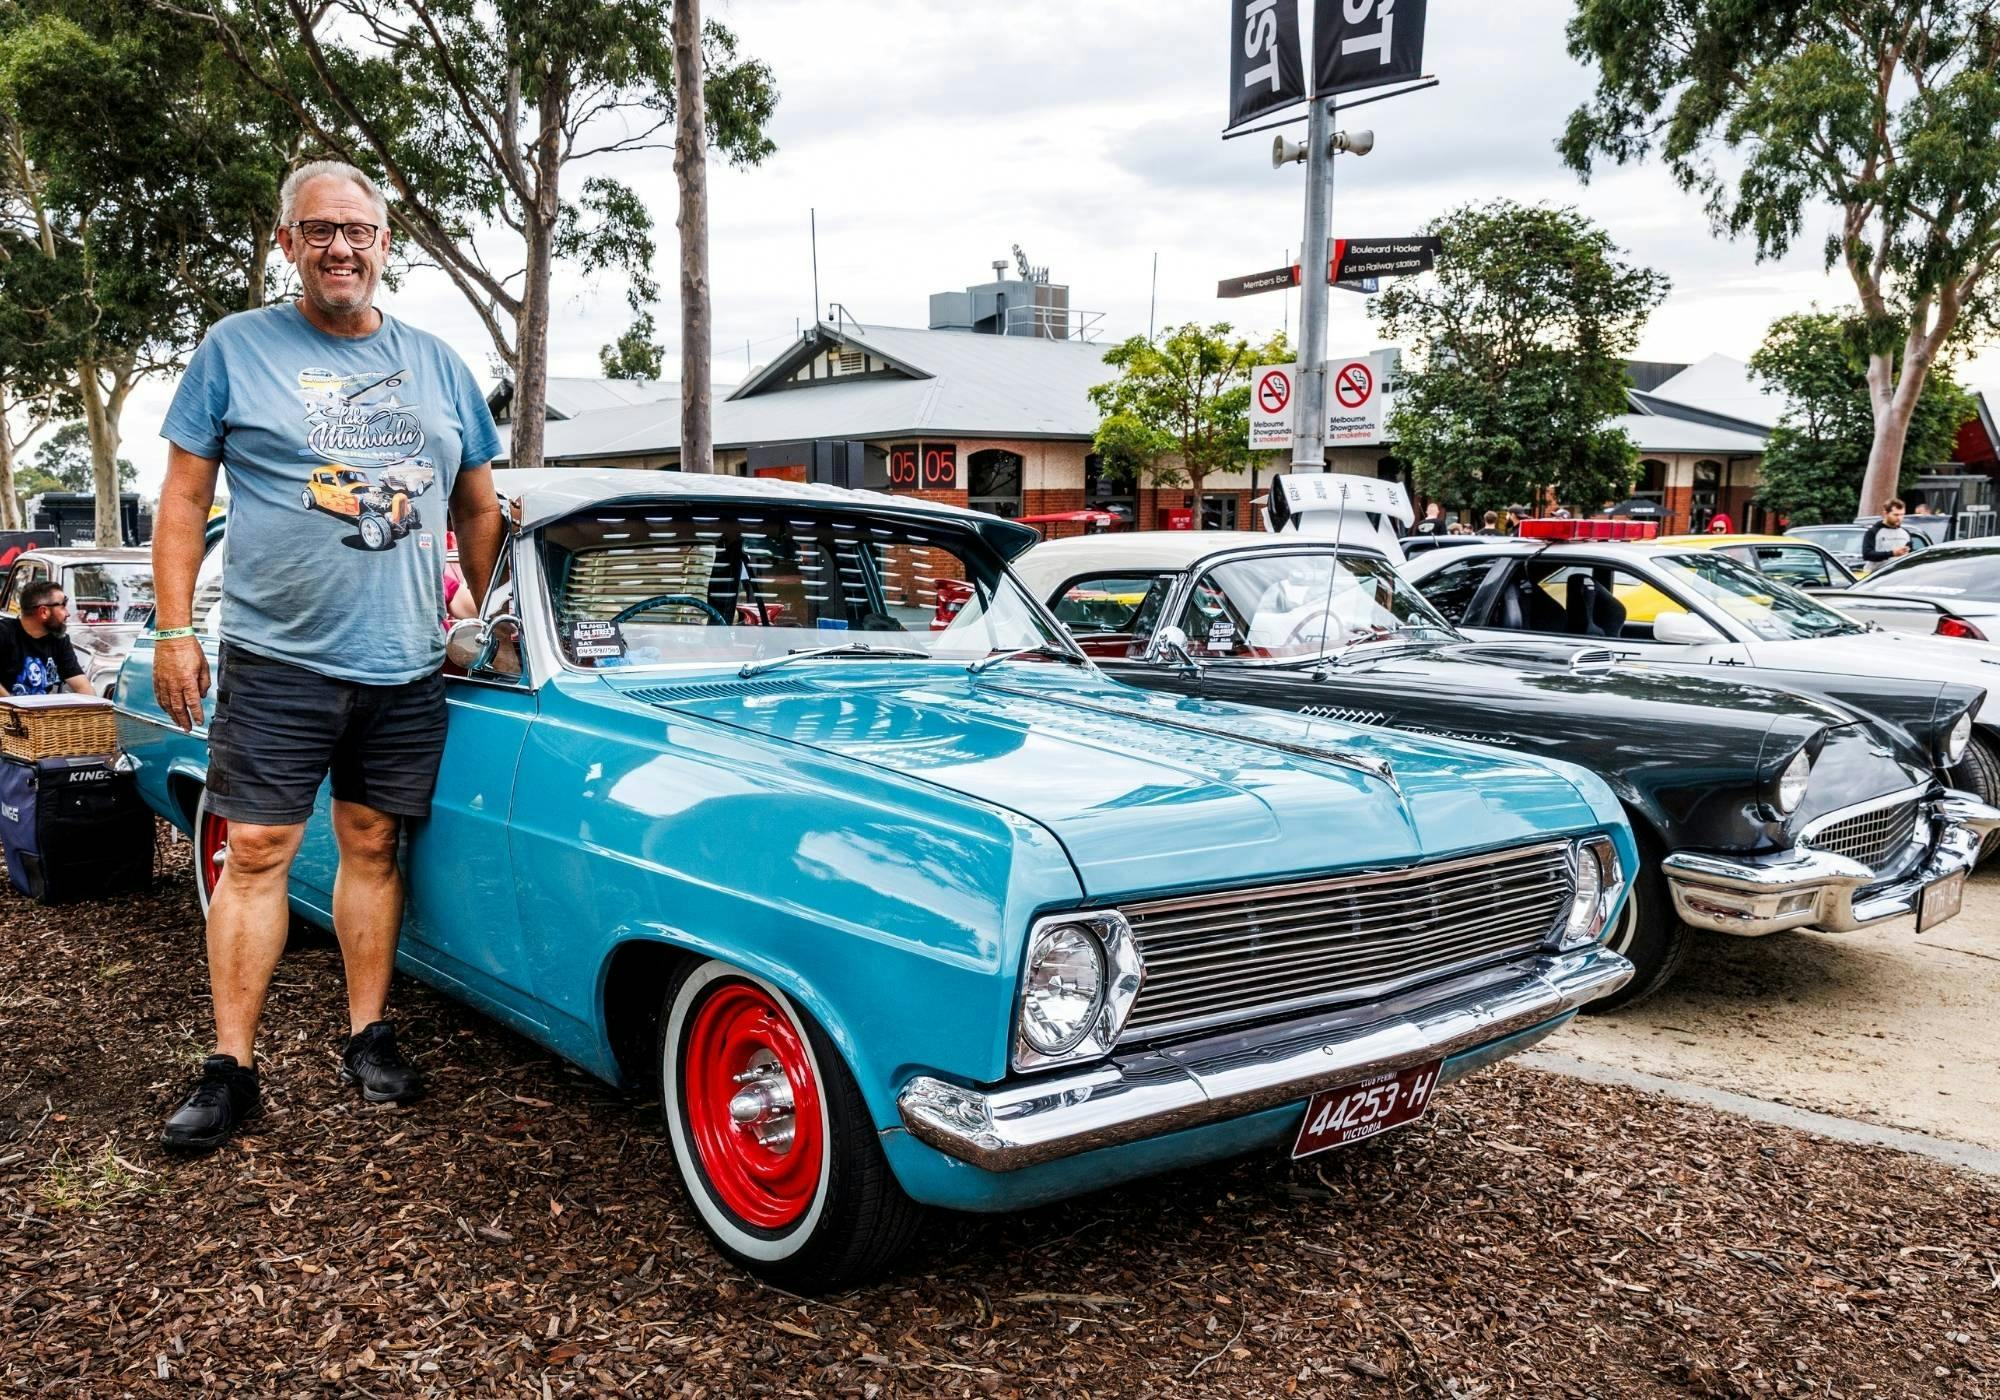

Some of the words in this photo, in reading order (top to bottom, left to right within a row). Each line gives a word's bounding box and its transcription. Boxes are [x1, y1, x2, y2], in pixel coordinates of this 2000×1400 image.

[1351, 244, 1391, 254] Boulevard
[1344, 265, 1357, 274] Exit
[1358, 264, 1366, 272] to
[1366, 261, 1395, 271] Railway
[1395, 259, 1421, 269] station
[1243, 278, 1275, 290] Members
[1276, 274, 1289, 284] Bar
[1330, 416, 1366, 424] Melbourne
[310, 418, 419, 450] Mulwala
[1253, 428, 1292, 436] Showgrounds
[1329, 423, 1376, 433] Showgrounds
[892, 451, 916, 483] 05
[925, 450, 955, 482] 05
[1342, 1120, 1382, 1141] VICTORIA
